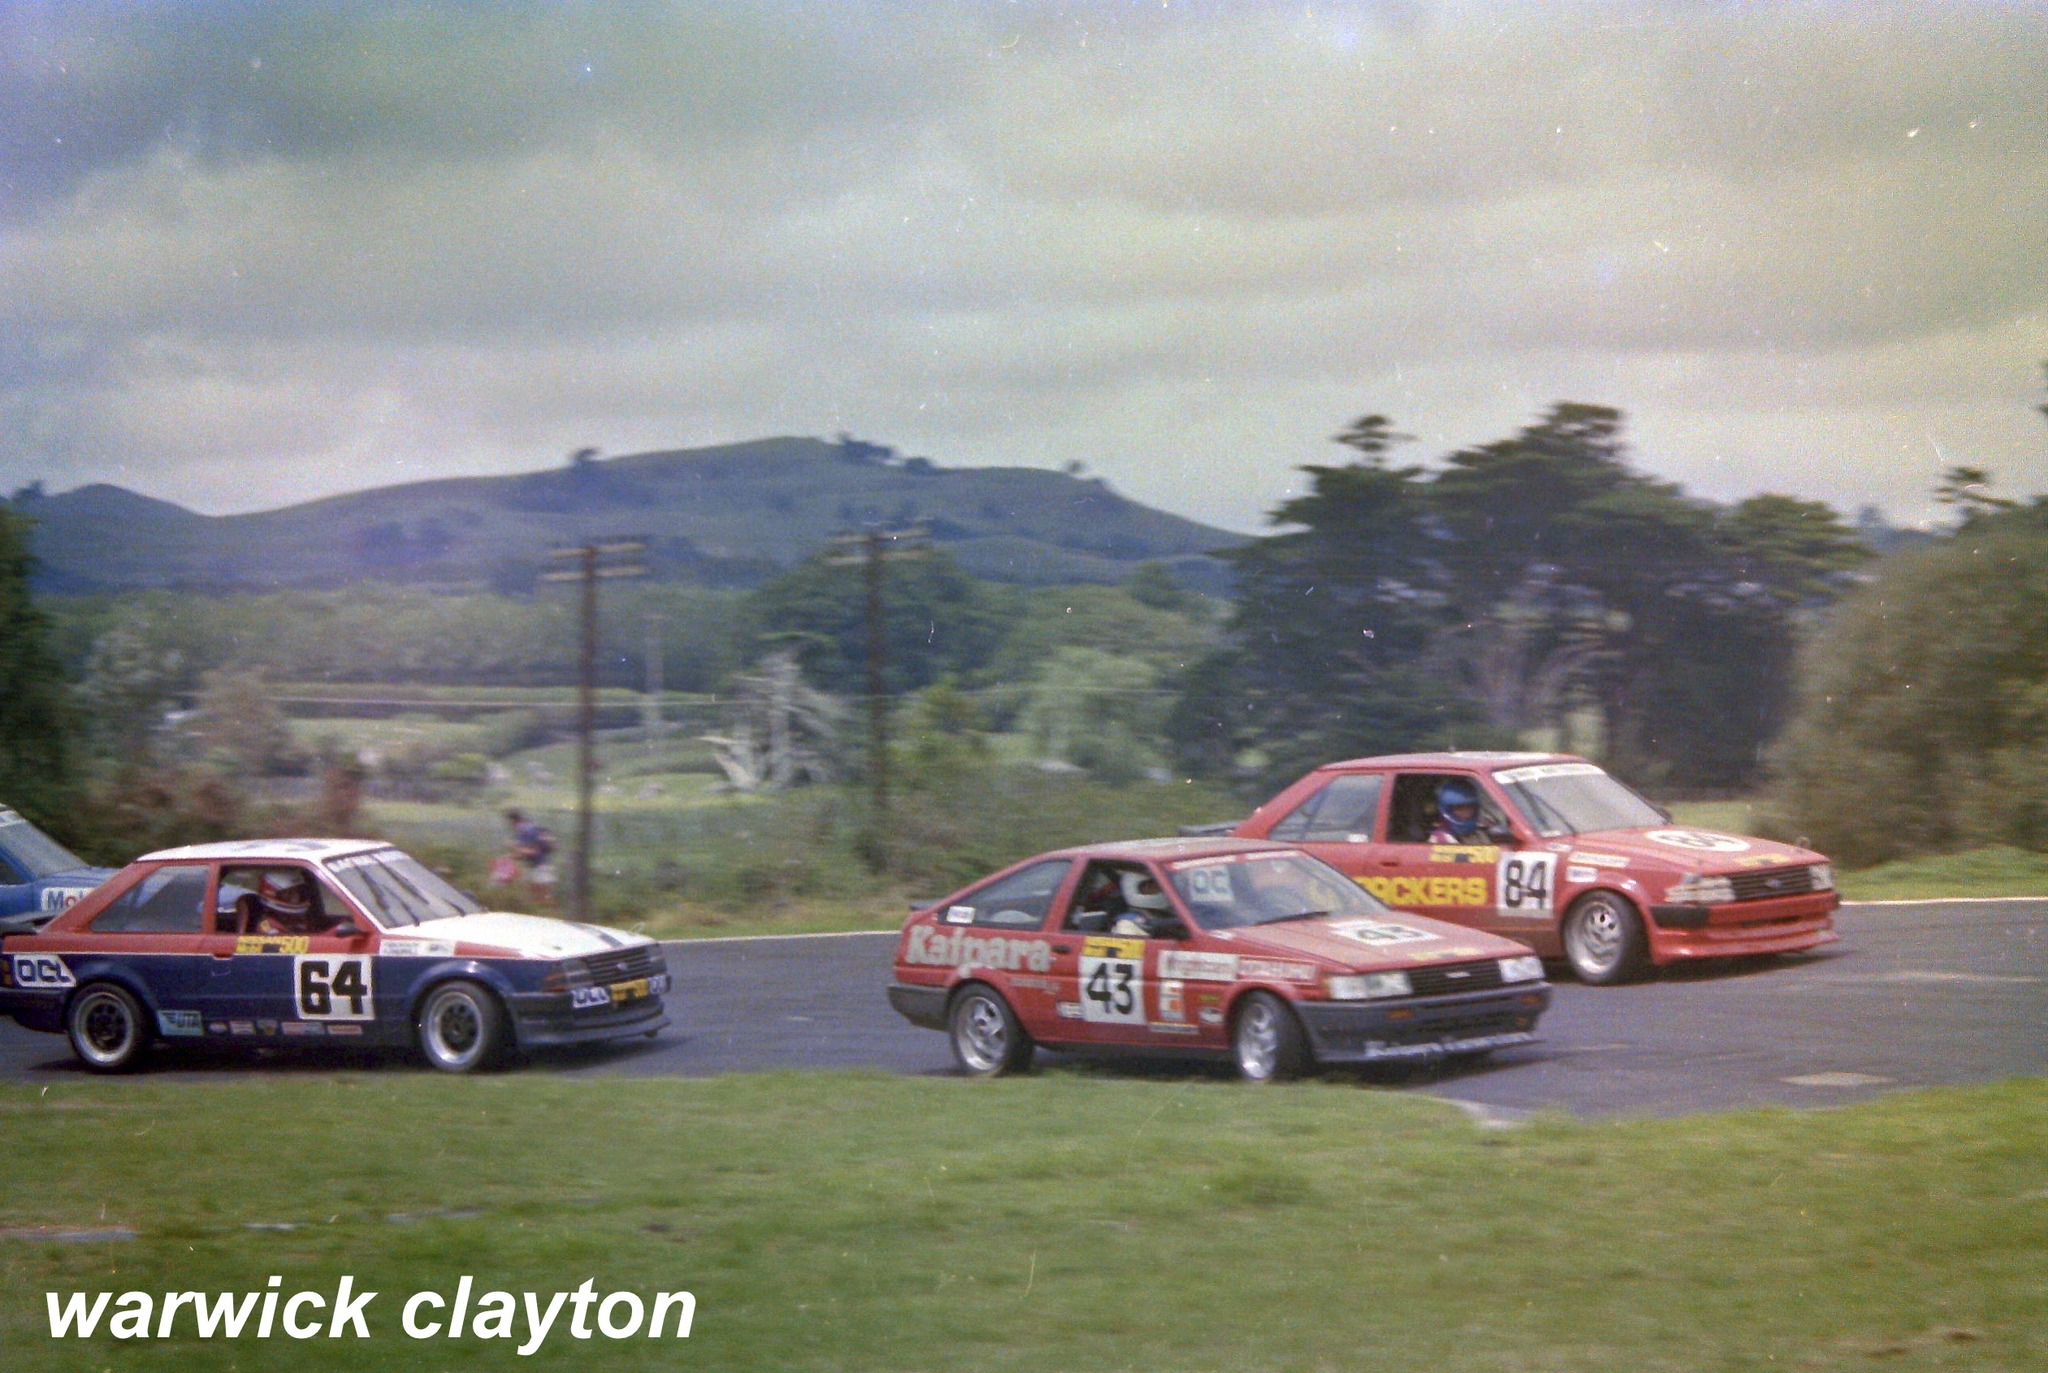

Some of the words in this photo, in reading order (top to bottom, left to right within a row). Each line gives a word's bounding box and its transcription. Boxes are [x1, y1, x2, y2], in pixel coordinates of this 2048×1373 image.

[1505, 860, 1546, 908] 84
[301, 961, 367, 1014] 64
[1088, 963, 1132, 1014] 43
